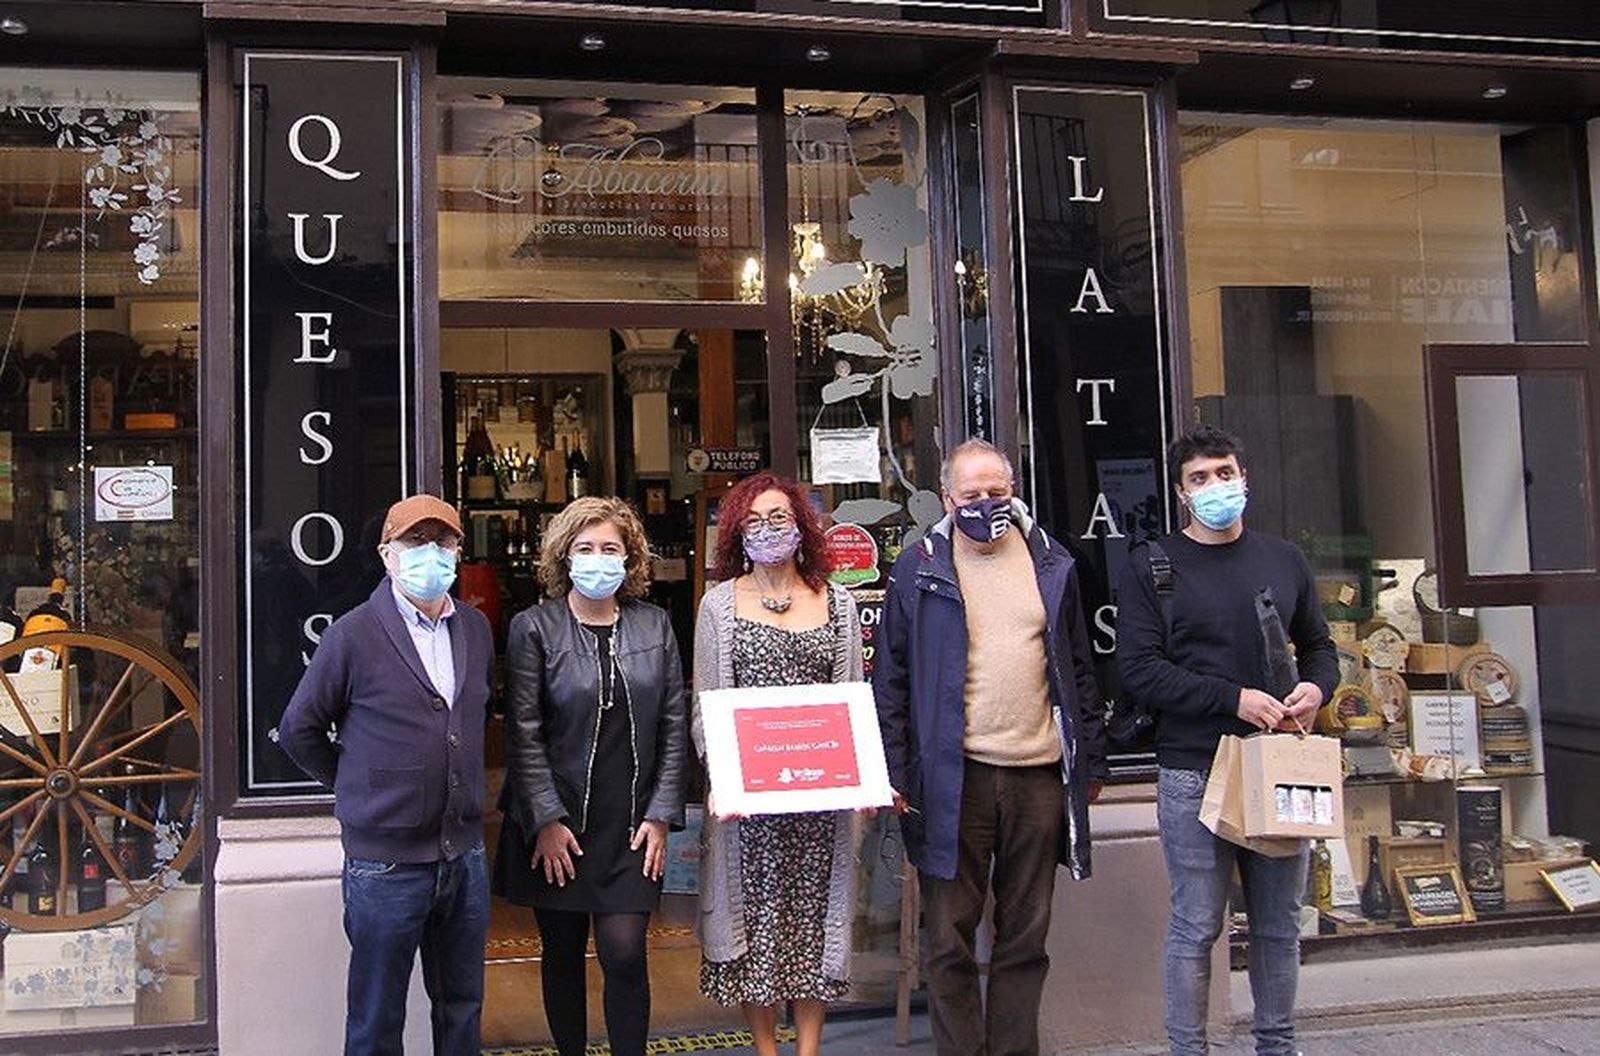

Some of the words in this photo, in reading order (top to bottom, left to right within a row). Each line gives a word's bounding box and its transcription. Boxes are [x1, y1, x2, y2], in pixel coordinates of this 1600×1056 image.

[286, 114, 362, 667] QUESOS
[583, 220, 667, 237] embutidos
[1066, 155, 1125, 654] LATAS
